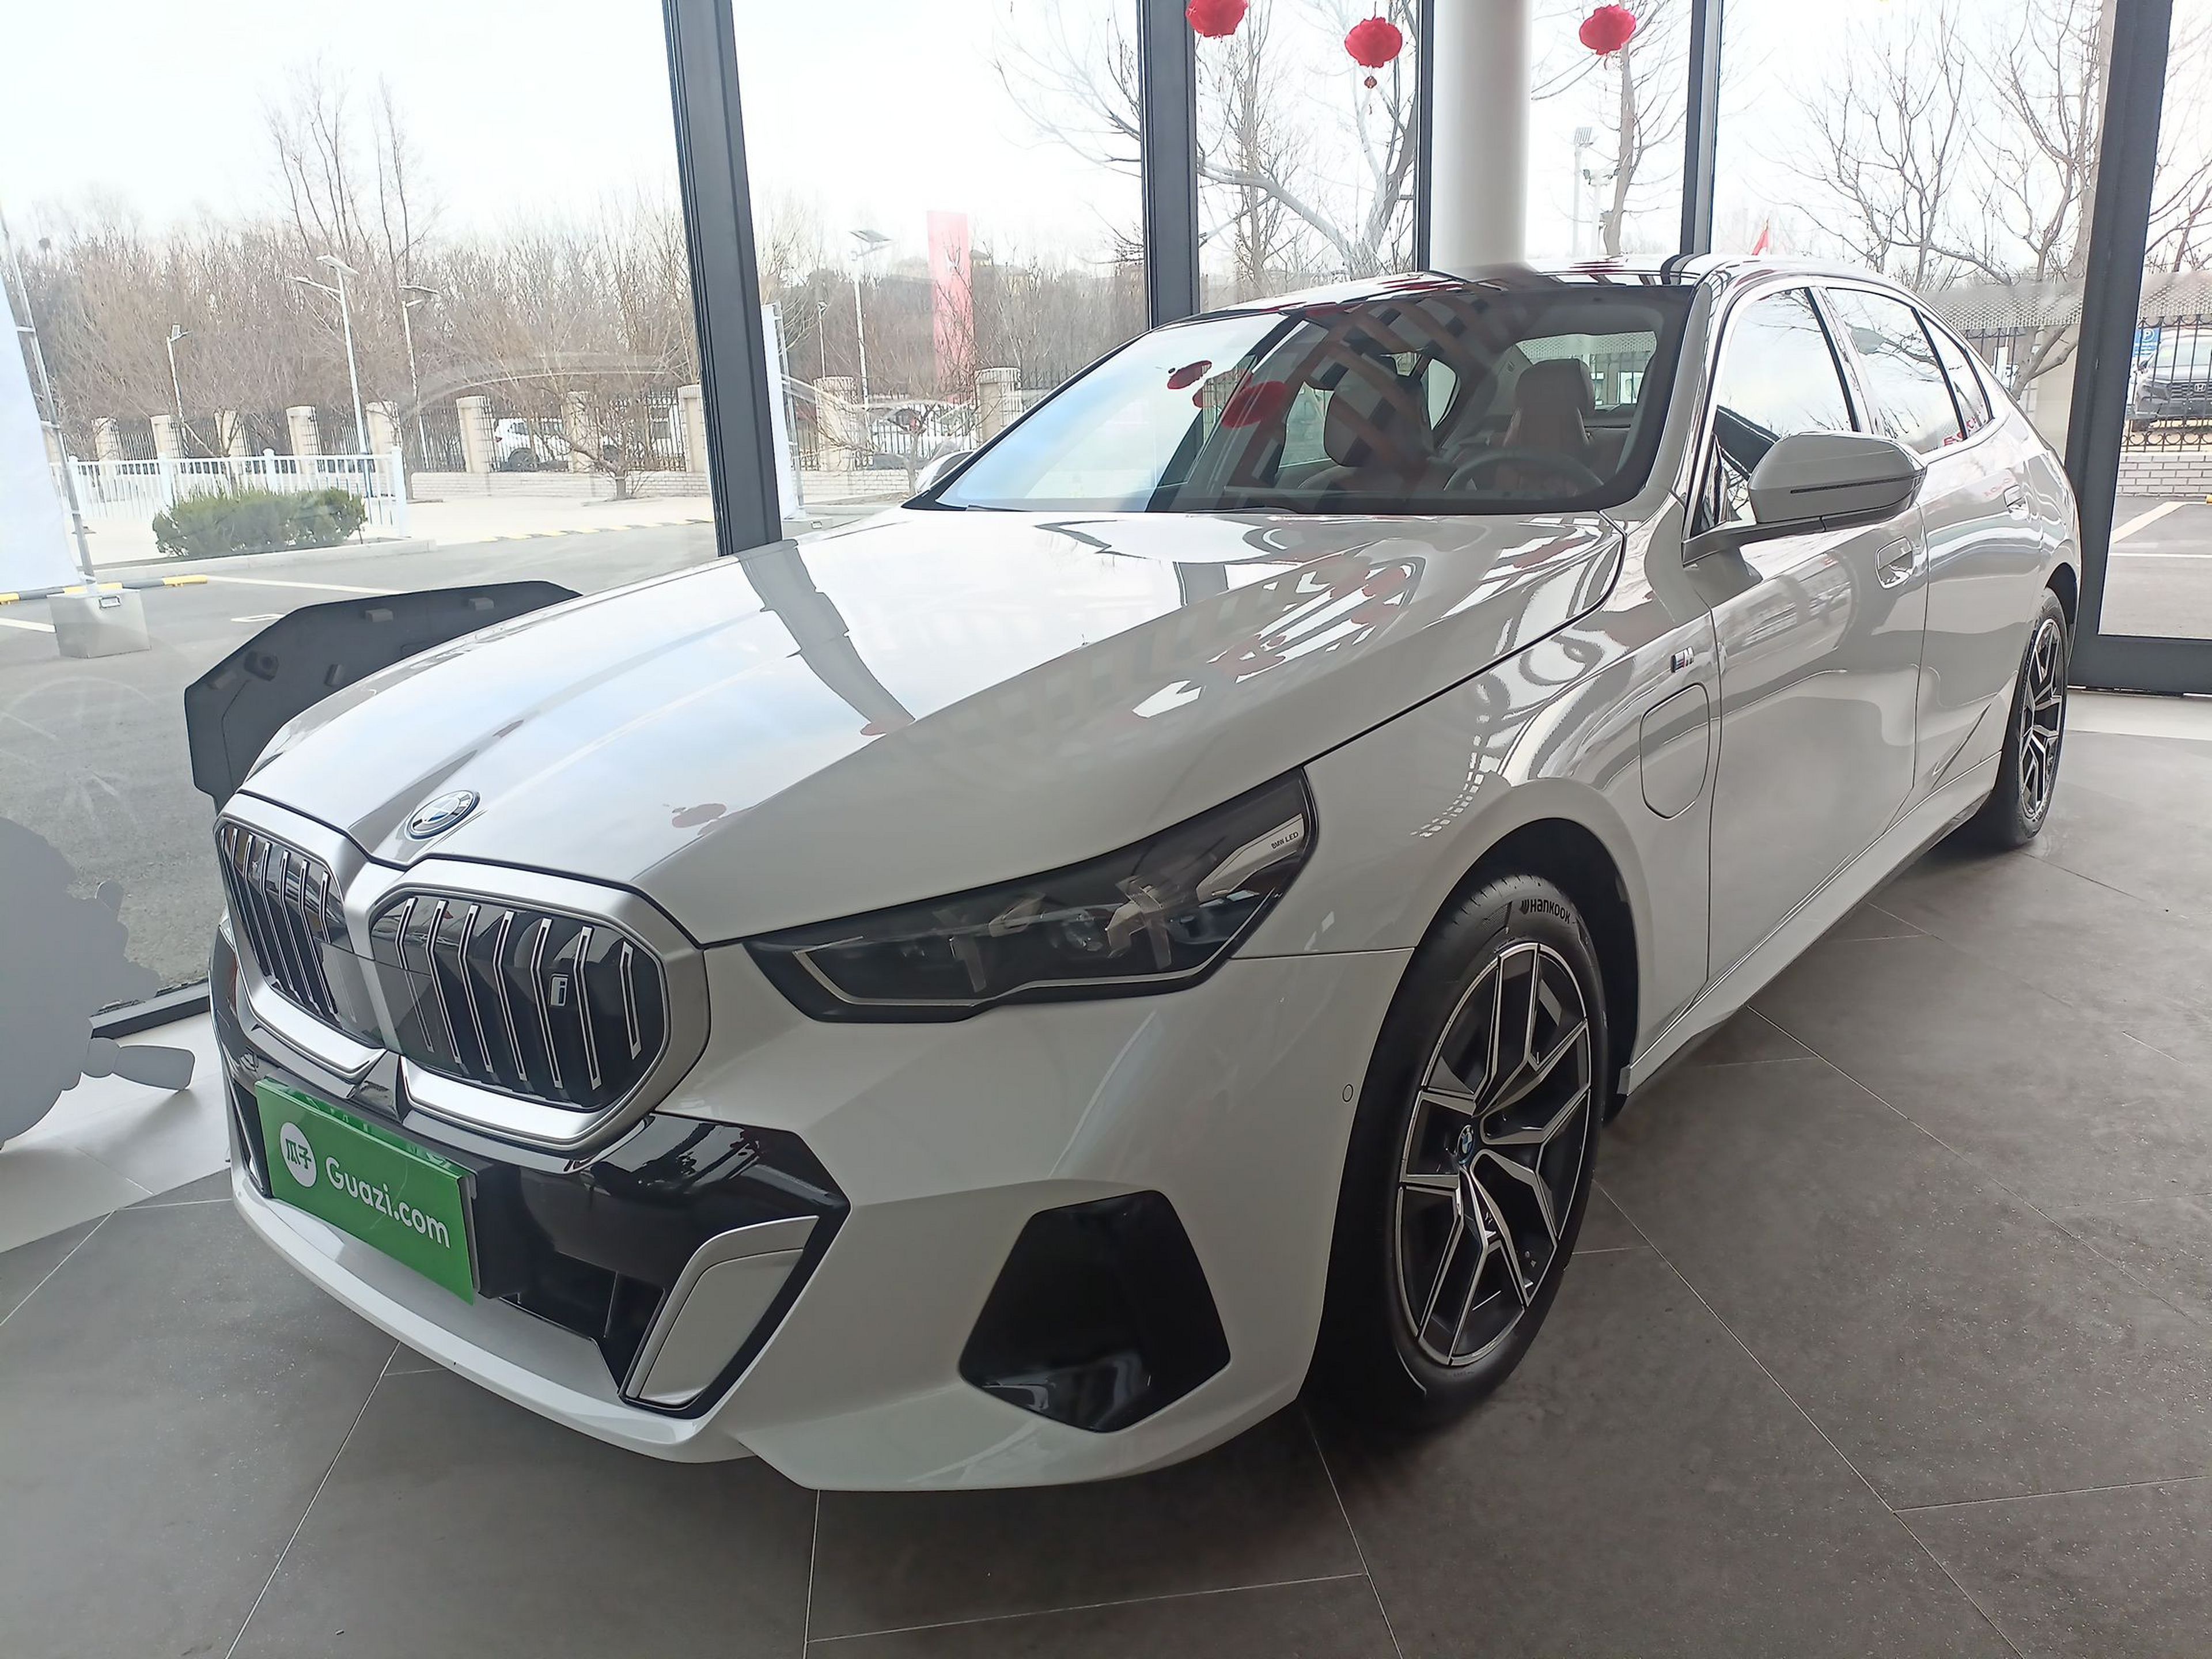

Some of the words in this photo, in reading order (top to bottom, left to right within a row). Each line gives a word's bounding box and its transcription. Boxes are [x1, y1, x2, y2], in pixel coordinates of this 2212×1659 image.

[1285, 831, 1298, 842] LED
[285, 1138, 312, 1170] 瓜子
[325, 1156, 450, 1249] Guazi.com
